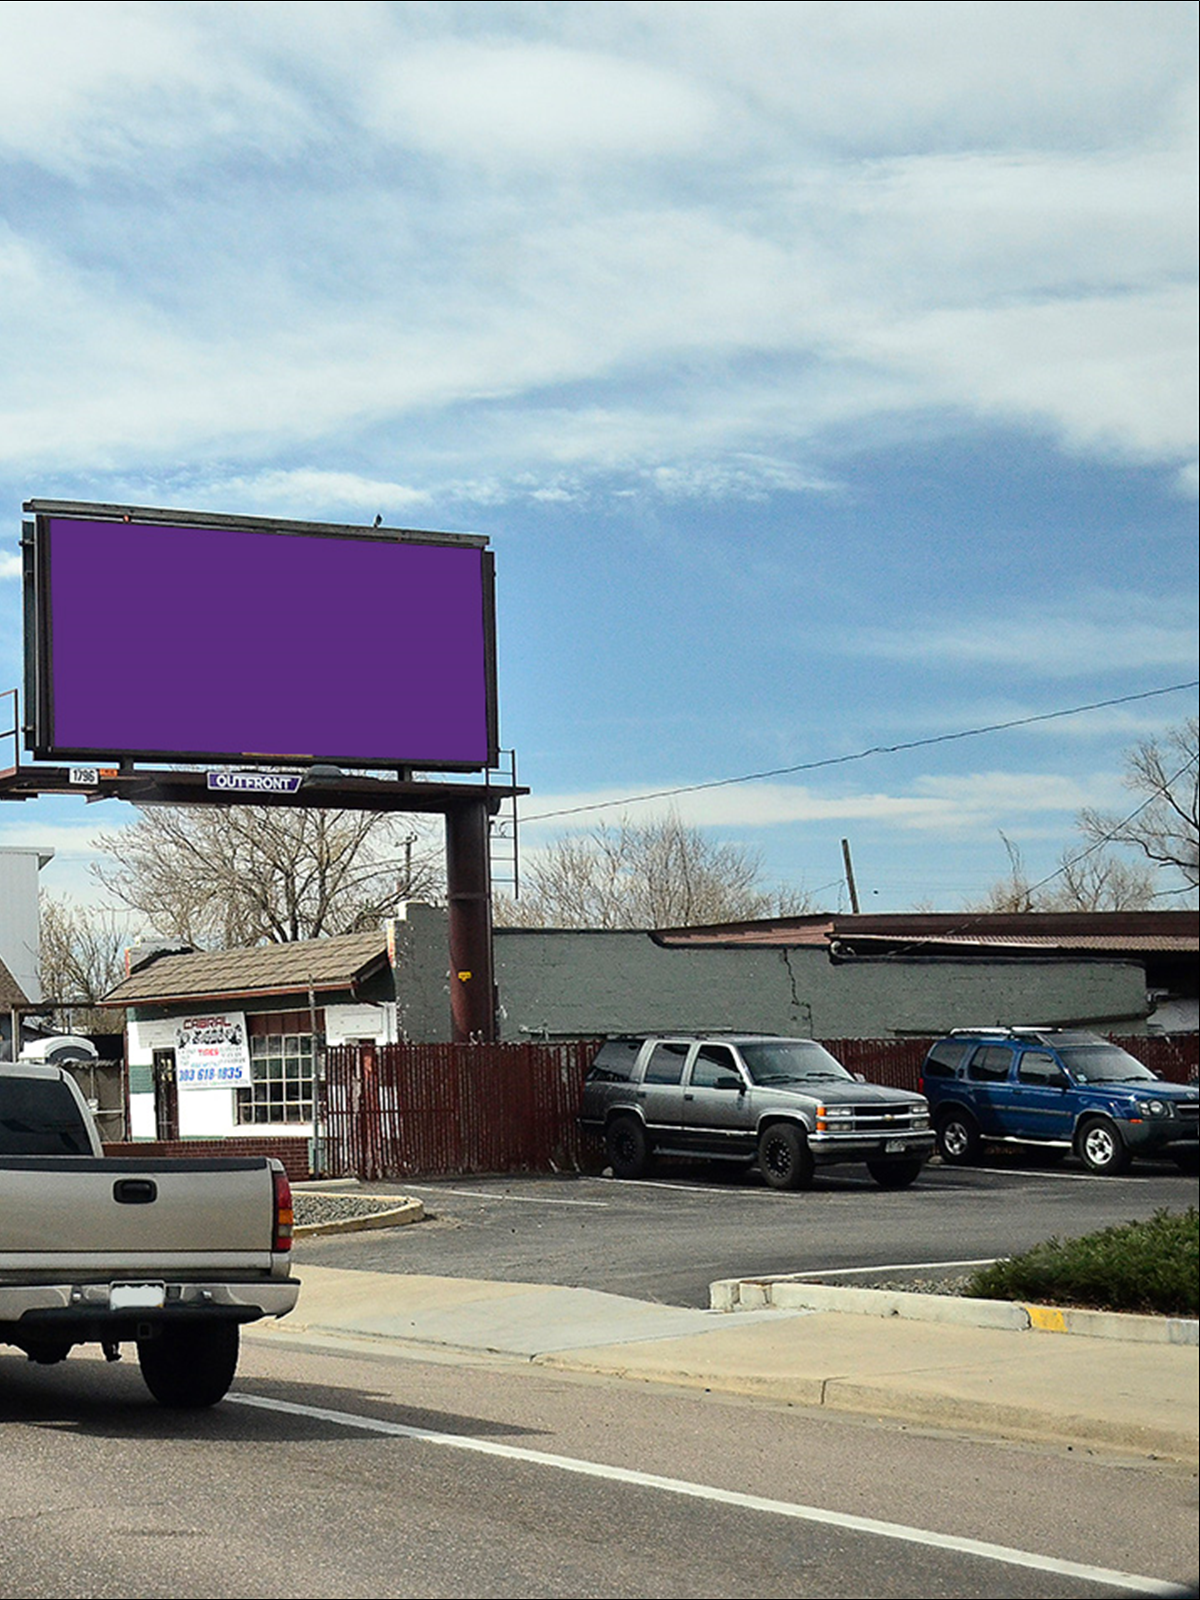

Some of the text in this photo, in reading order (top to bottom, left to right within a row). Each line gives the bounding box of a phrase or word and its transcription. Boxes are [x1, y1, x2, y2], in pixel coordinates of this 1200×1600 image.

[73, 769, 96, 782] 1796
[216, 775, 292, 790] OUTFRONT
[183, 1016, 232, 1030] CABRAL
[198, 1047, 219, 1057] TIRES
